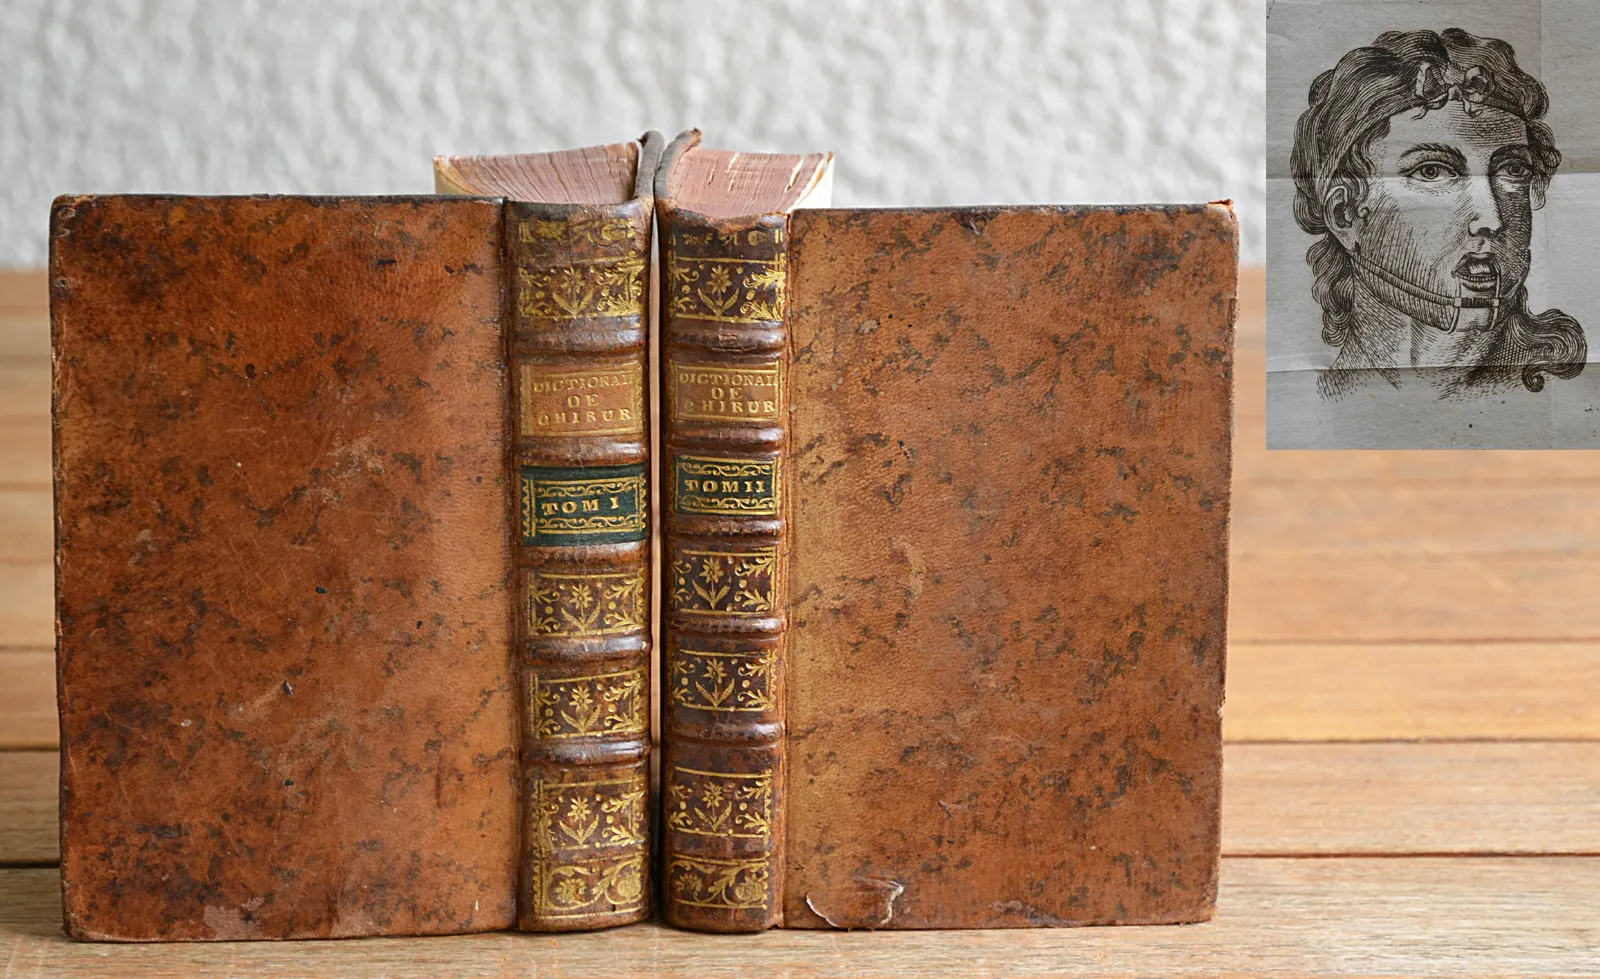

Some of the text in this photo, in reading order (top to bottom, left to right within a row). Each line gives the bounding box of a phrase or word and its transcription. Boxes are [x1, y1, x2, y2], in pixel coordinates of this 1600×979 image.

[679, 373, 778, 386] DICTIONAI
[567, 393, 600, 408] DE
[711, 387, 743, 400] DE
[541, 496, 620, 516] TOM I
